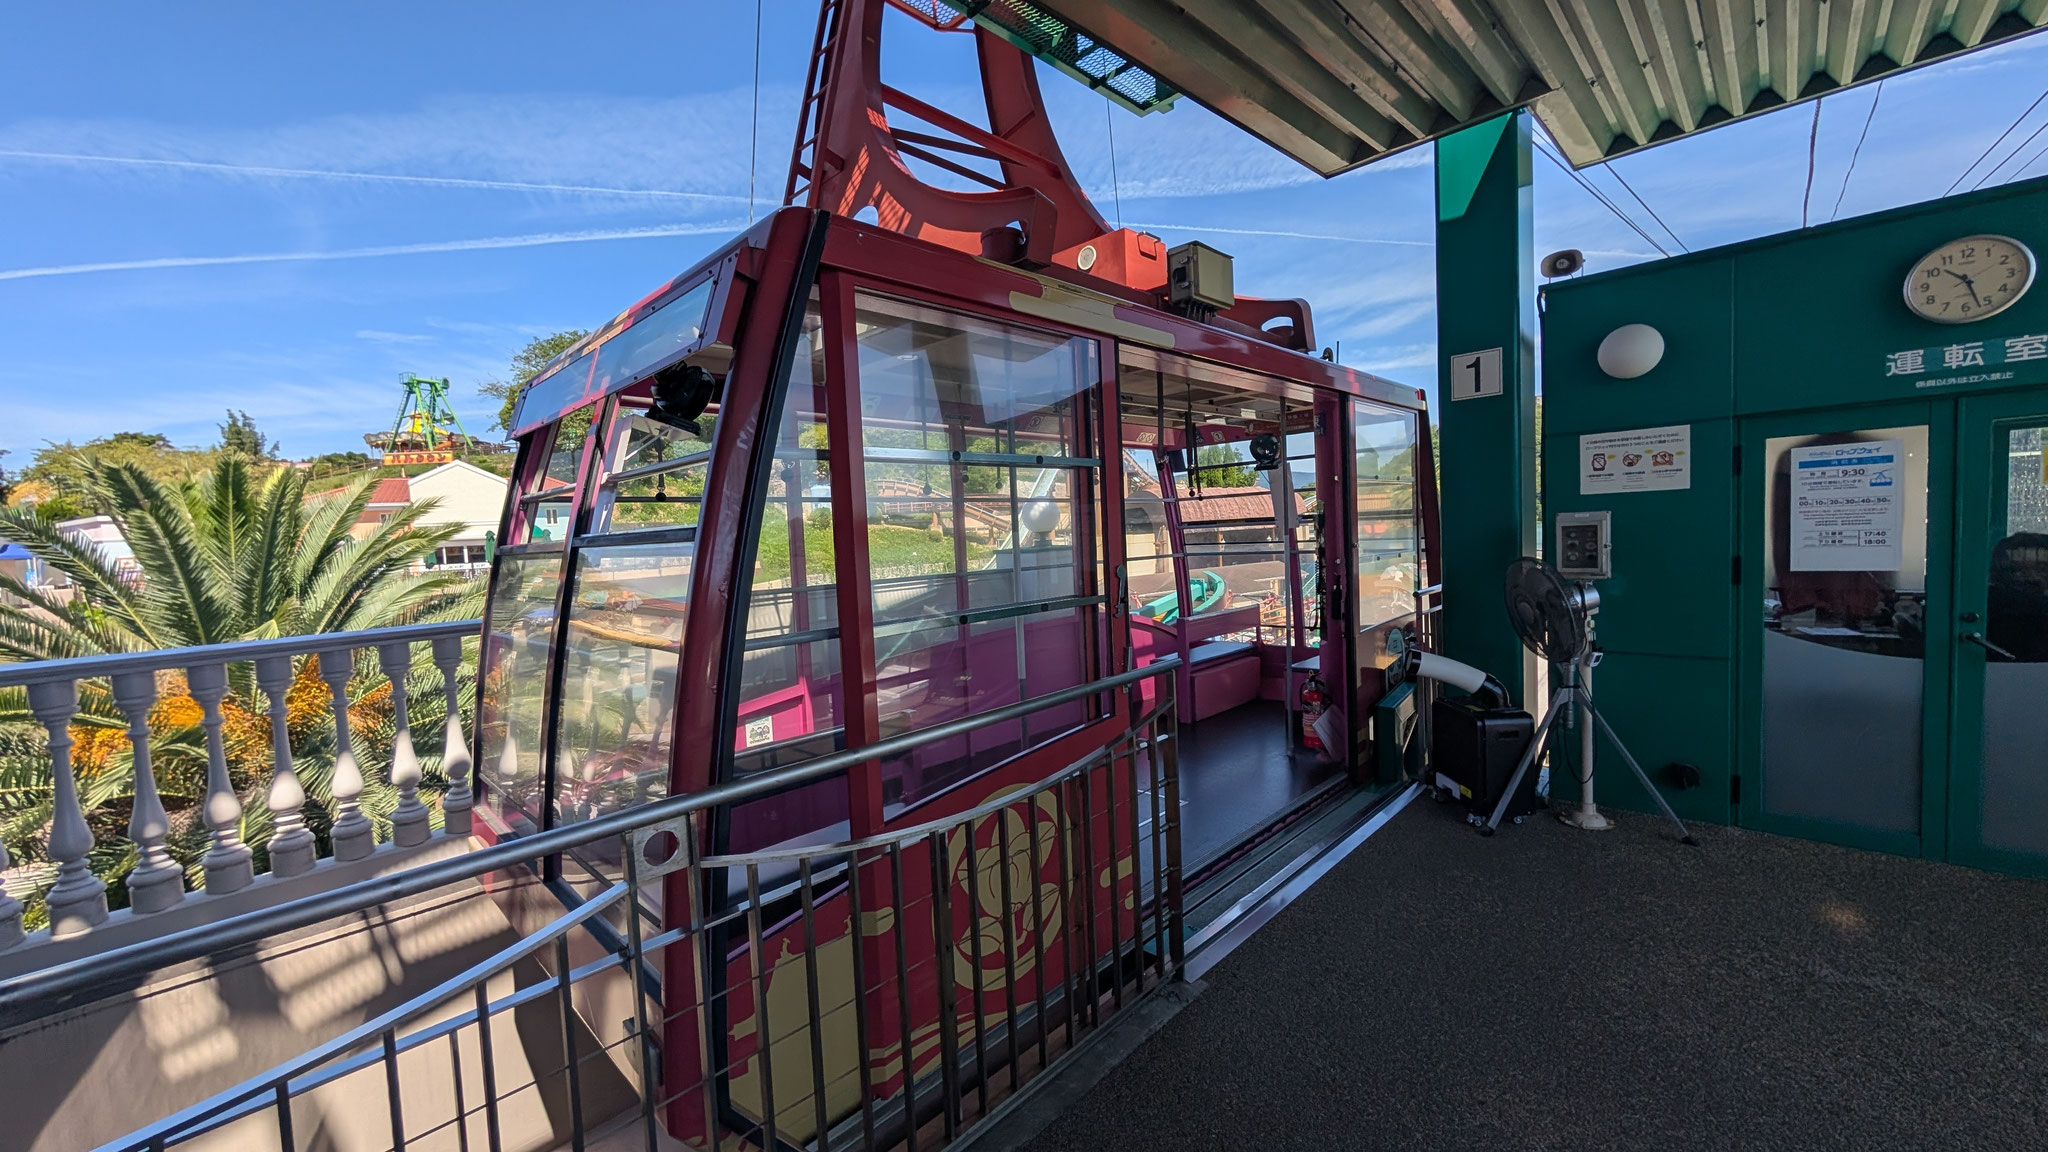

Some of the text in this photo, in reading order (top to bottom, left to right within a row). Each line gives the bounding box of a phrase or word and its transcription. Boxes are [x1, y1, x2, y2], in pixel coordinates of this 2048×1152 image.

[1960, 247, 1976, 259] 12
[1985, 248, 1992, 258] 1
[1941, 255, 1953, 266] 11
[1999, 254, 2010, 266] 2
[1926, 267, 1941, 279] 10
[2006, 267, 2016, 279] 3
[1920, 282, 1930, 293] 9
[1997, 283, 2009, 293] 4
[1926, 294, 1936, 305] 8
[1983, 295, 1993, 306] 5
[1941, 301, 1951, 312] 7
[1961, 301, 1971, 313] 6
[1885, 334, 2048, 377] 運転室
[1465, 356, 1481, 393] 1
[1841, 468, 1865, 477] 9:30
